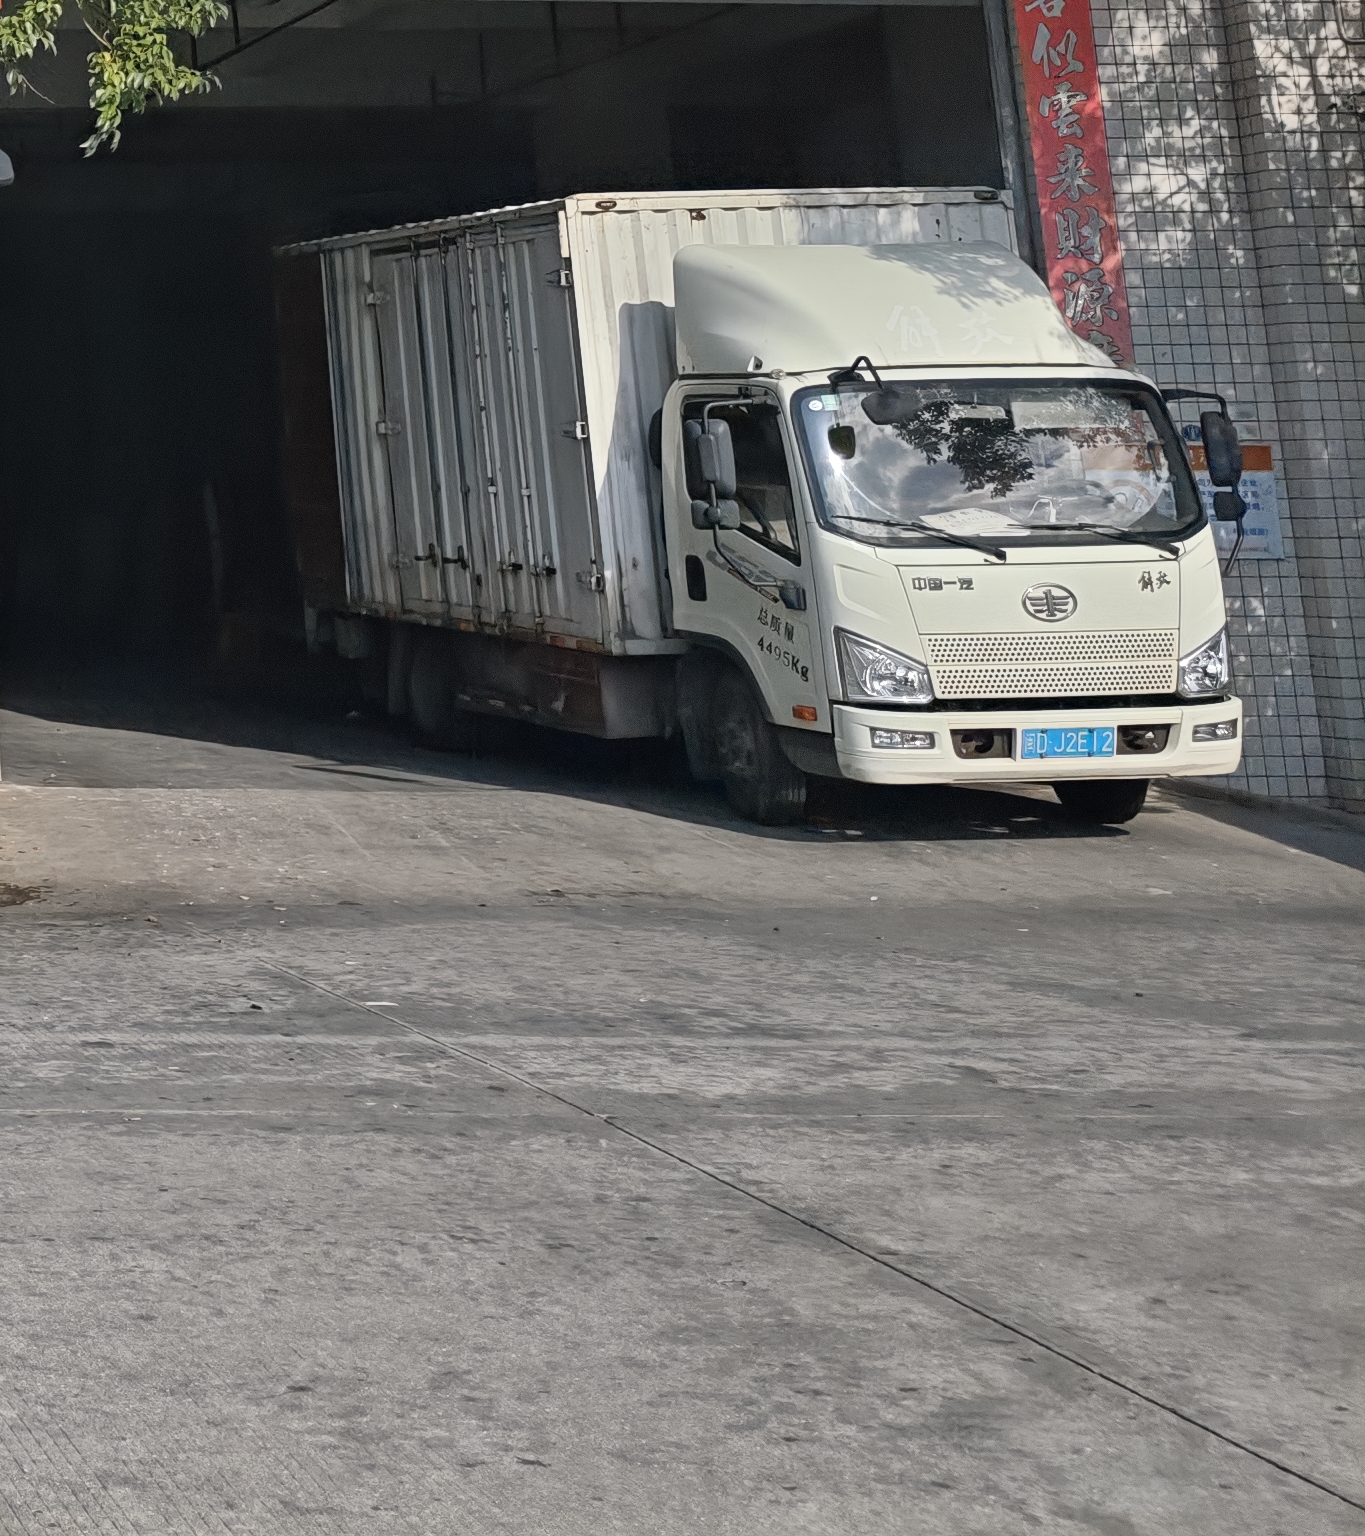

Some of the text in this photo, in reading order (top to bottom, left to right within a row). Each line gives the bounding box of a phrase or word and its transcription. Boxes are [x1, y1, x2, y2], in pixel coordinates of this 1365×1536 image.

[911, 577, 974, 590] 中国一汽
[757, 606, 795, 644] 总质量
